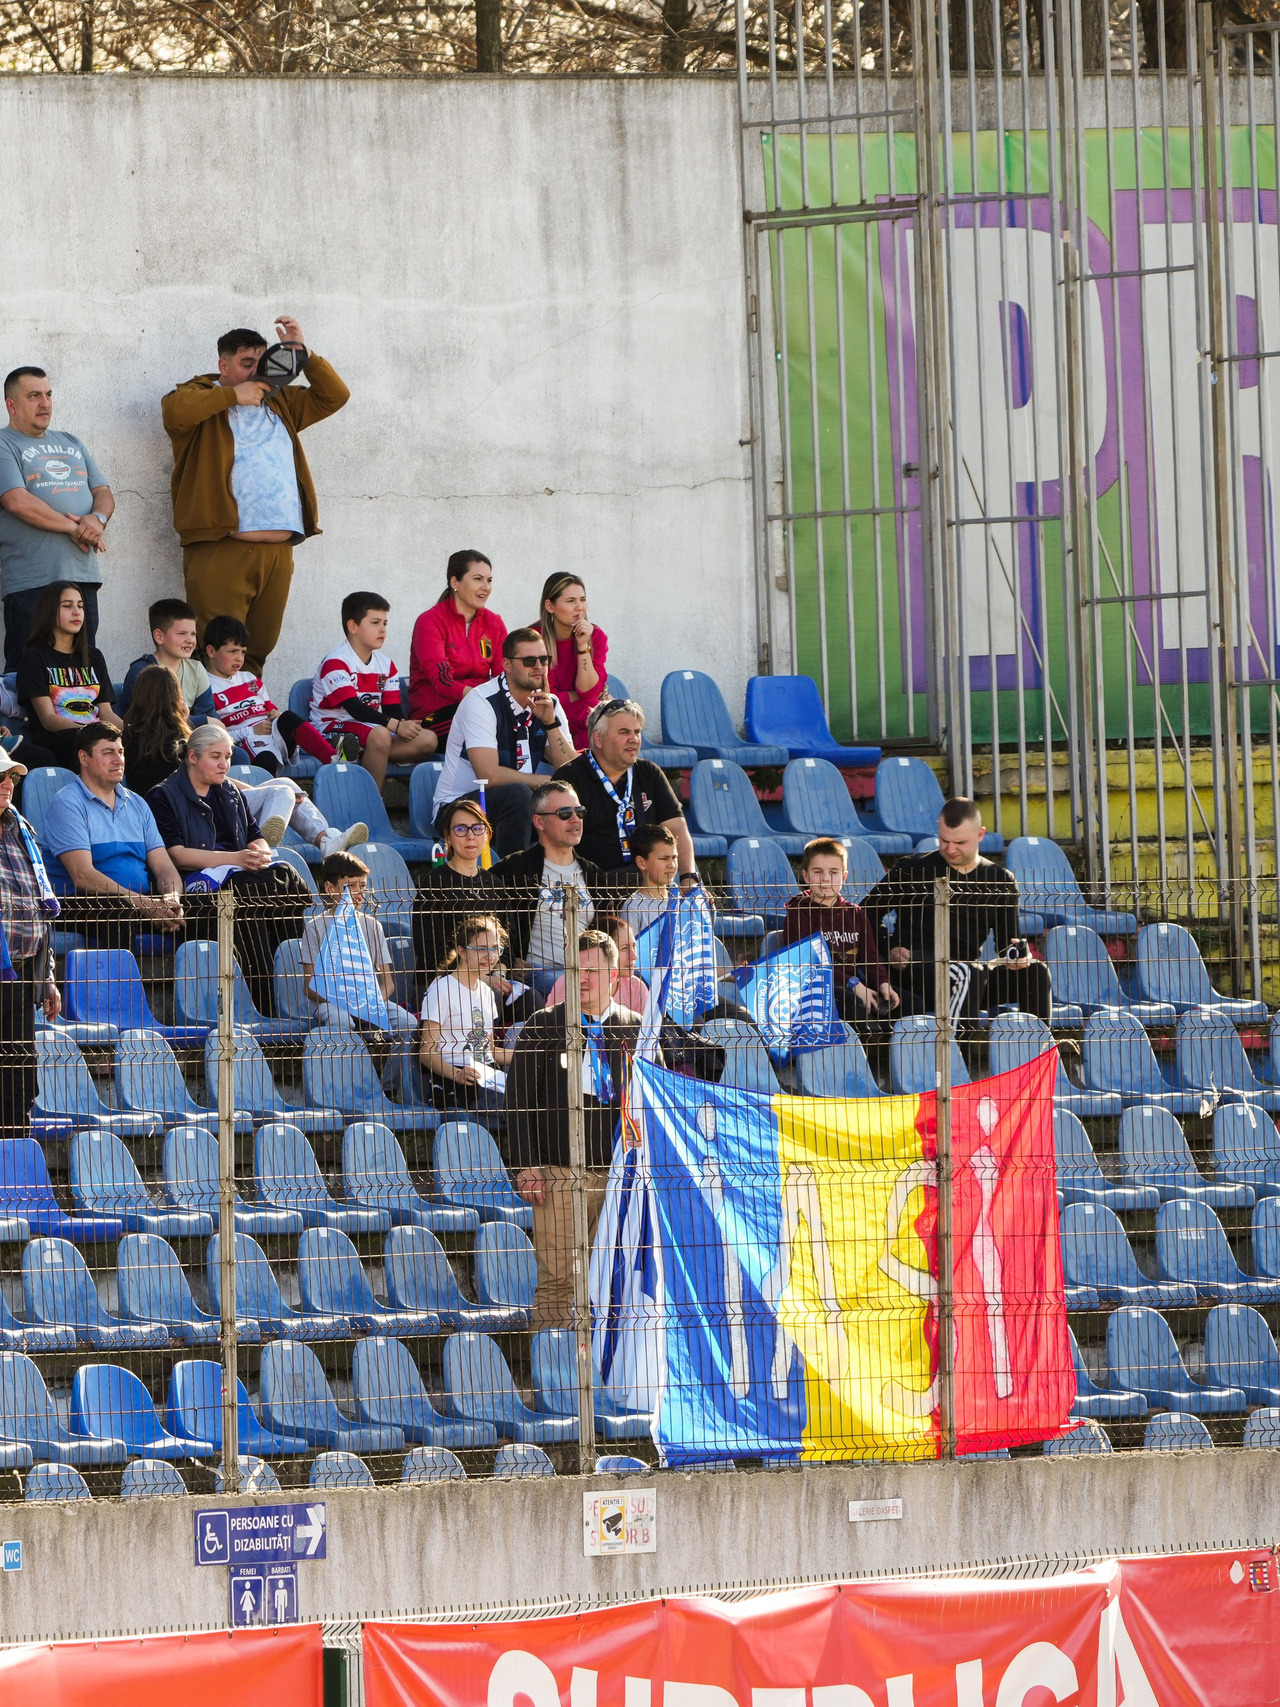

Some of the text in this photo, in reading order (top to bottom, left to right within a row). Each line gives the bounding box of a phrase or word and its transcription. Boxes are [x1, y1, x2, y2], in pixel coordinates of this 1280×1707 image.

[38, 444, 82, 460] TAILOR
[47, 666, 100, 686] NIRVANA
[229, 709, 250, 722] AUTO
[231, 1514, 294, 1531] PERSOANE CU
[5, 1549, 20, 1563] WC
[240, 1568, 257, 1576] FEMEI
